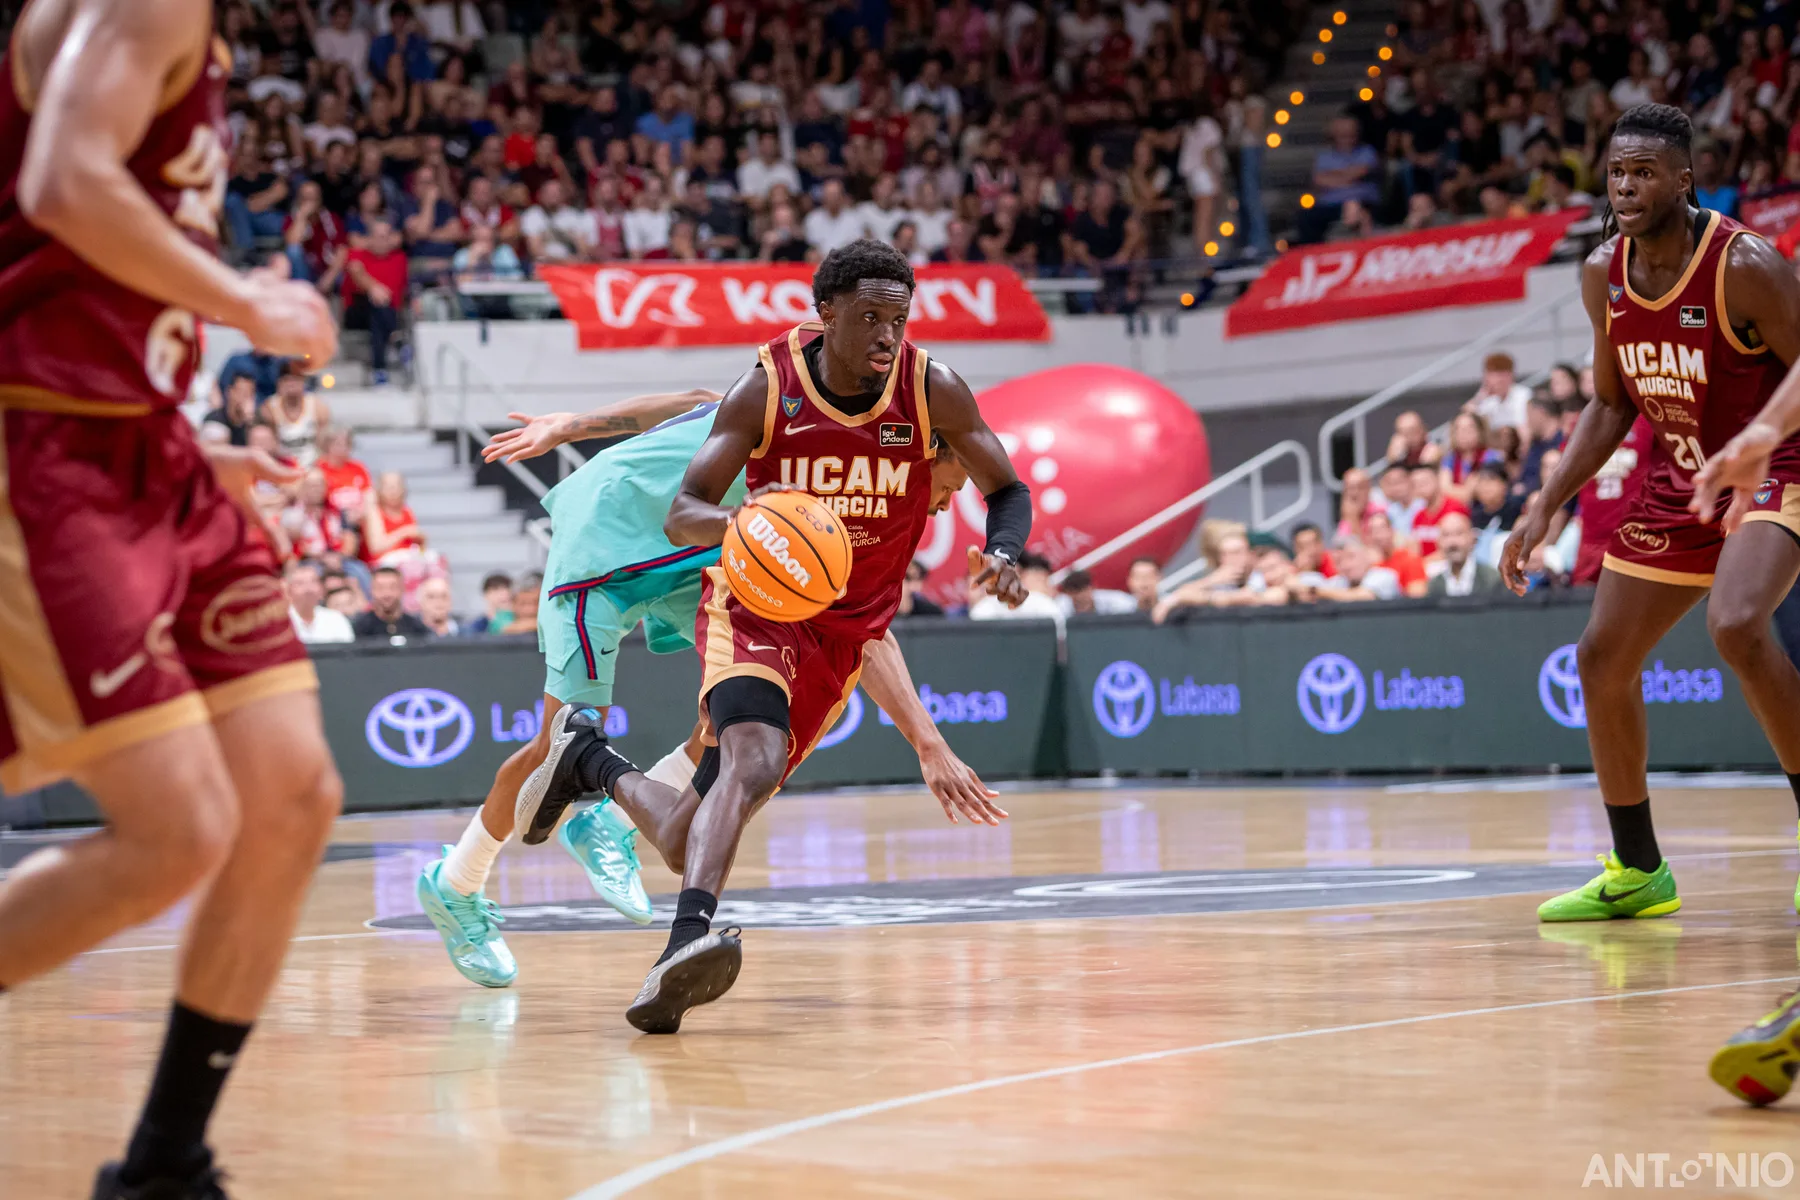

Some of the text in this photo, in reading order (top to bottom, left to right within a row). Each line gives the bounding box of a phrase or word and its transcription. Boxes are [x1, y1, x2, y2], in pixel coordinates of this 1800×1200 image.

[1617, 341, 1709, 384] UCAM
[1634, 376, 1696, 403] MURCIA
[780, 455, 912, 497] UCAM
[817, 495, 889, 518] URCIA
[747, 512, 812, 588] Wilson
[1160, 675, 1241, 716] Labasa
[1373, 667, 1465, 711] Labasa
[1641, 660, 1724, 704] abasa
